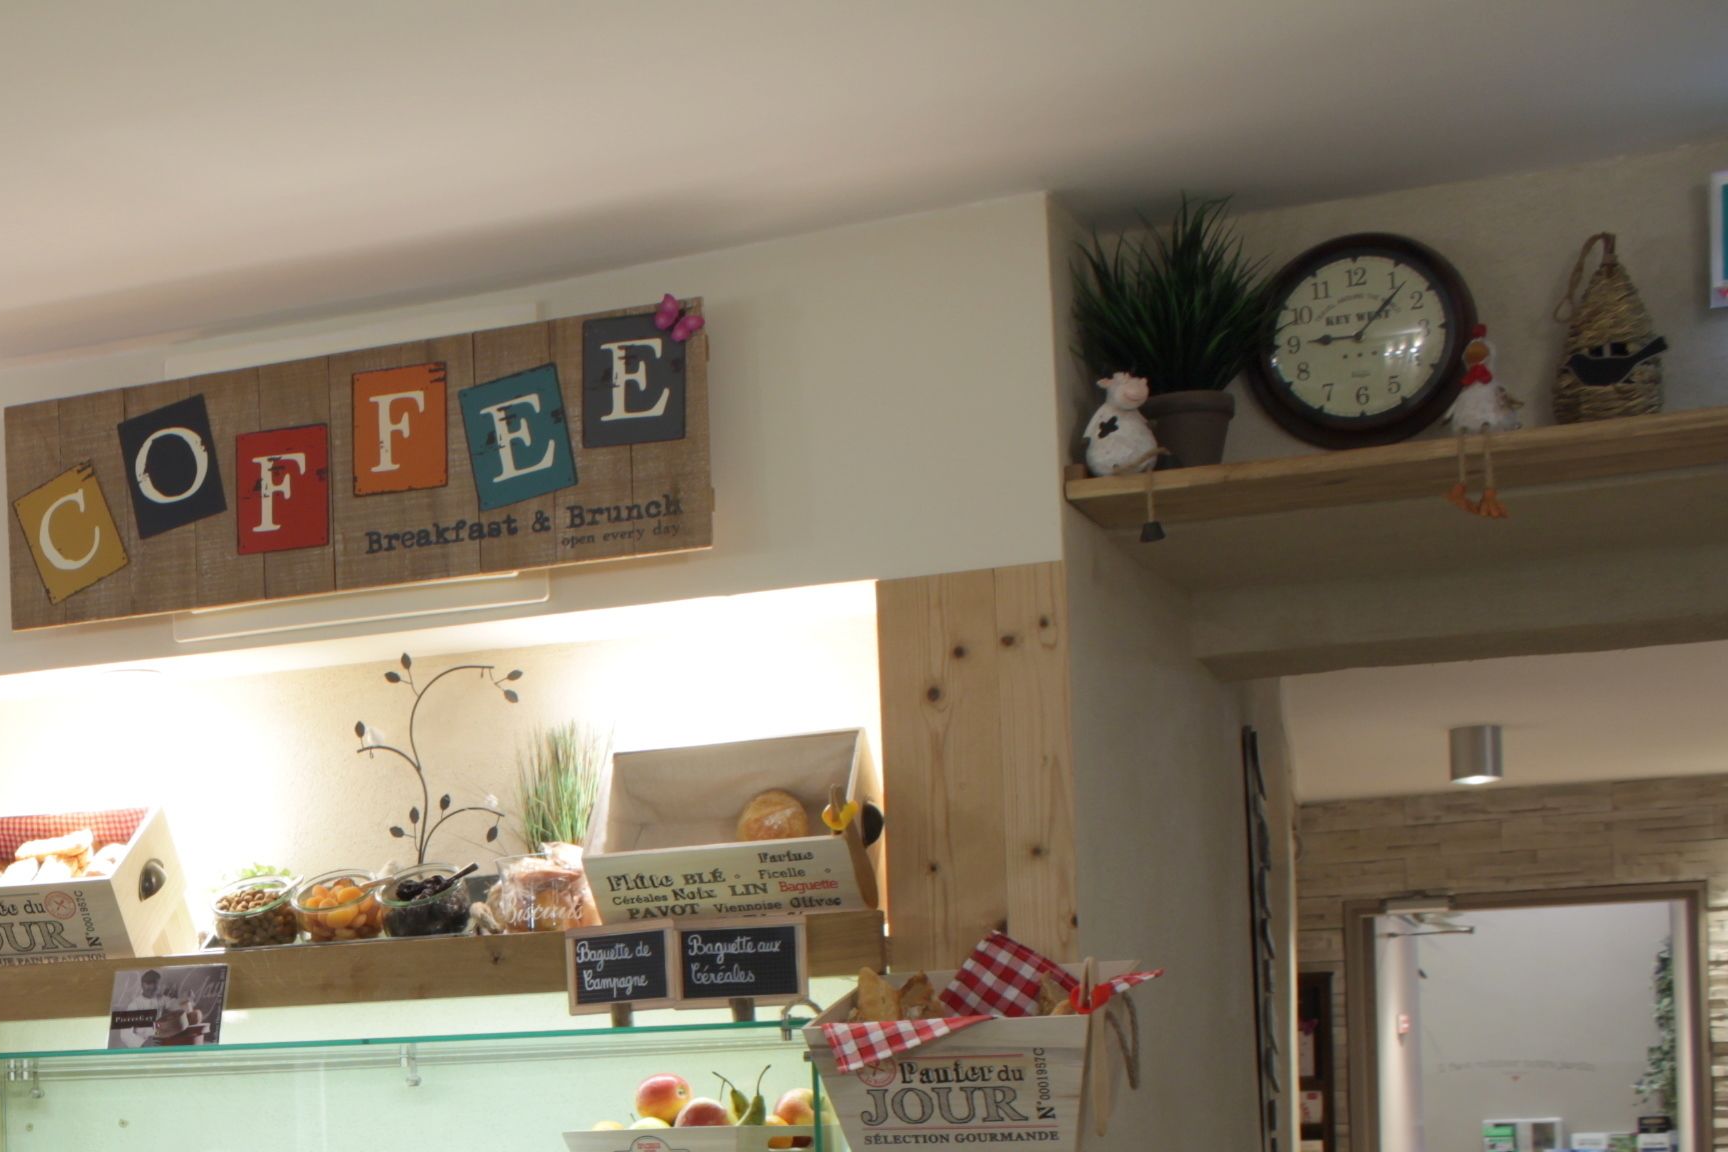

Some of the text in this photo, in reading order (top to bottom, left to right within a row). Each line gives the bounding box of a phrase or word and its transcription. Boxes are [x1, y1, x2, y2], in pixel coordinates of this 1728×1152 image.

[1345, 267, 1367, 288] 12
[1312, 281, 1330, 300] 11
[1410, 291, 1424, 311] 2
[1287, 336, 1301, 354] 9
[1297, 362, 1310, 381] 8
[1356, 386, 1370, 405] 6
[38, 336, 670, 570] COFFEE
[365, 494, 684, 554] Breakfast & Brunch
[562, 520, 681, 549] open every day
[682, 868, 726, 885] BLÉ
[758, 868, 806, 880] Ficelle
[612, 894, 668, 906] Céréales
[728, 882, 769, 896] LIN
[778, 879, 839, 893] Baguette
[24, 900, 46, 914] du
[627, 903, 701, 920] PAVOT
[714, 900, 783, 914] Viennoise
[576, 940, 652, 972] Baguette de
[688, 934, 783, 964] Baguette aux
[583, 969, 648, 998] Campagne
[690, 963, 756, 985] Céréales
[899, 1059, 994, 1084] Panier
[997, 1064, 1024, 1081] du
[860, 1086, 1029, 1126] JOUR
[864, 1131, 1060, 1145] SÉLECTION GOURMANDE
